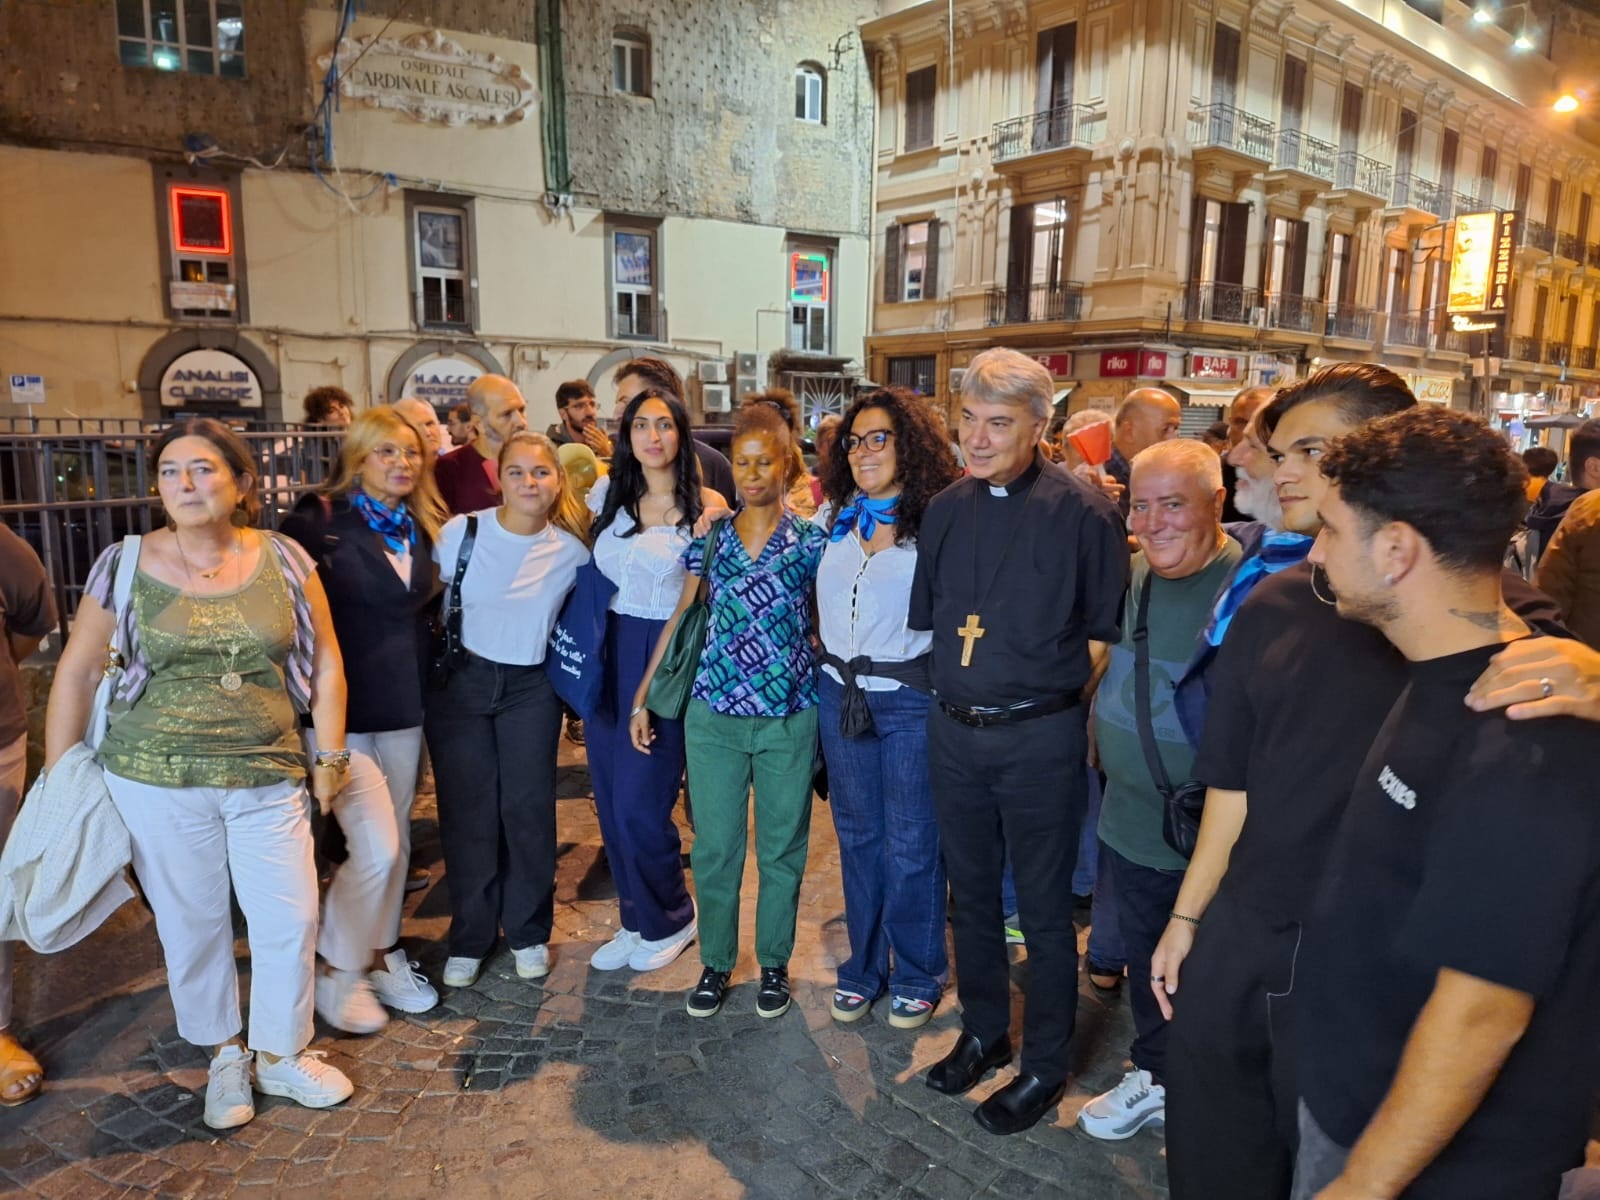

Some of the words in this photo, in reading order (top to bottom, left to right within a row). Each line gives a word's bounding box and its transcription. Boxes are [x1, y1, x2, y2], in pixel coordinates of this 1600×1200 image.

[401, 60, 465, 79] OSPEDALE
[1492, 213, 1514, 308] PIZZERIA
[1202, 357, 1228, 370] BAR
[173, 370, 249, 382] ANALISI
[169, 386, 253, 400] CLINICHE
